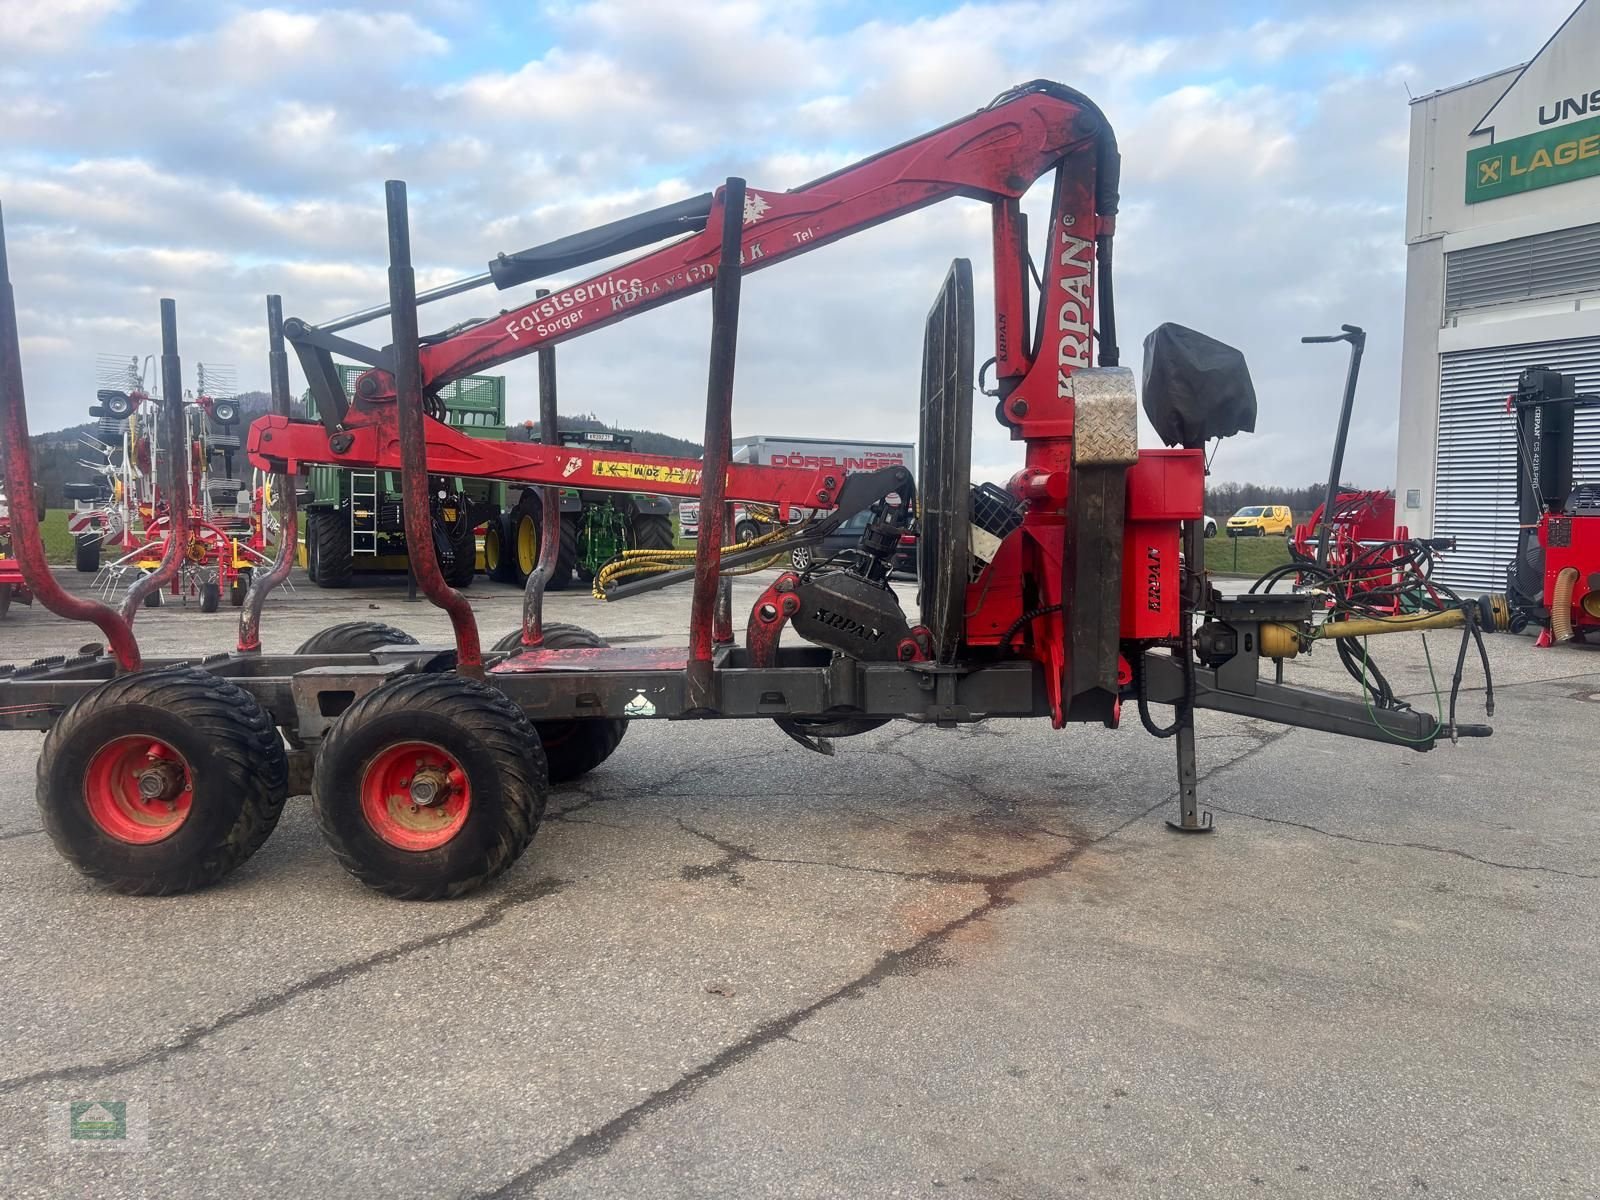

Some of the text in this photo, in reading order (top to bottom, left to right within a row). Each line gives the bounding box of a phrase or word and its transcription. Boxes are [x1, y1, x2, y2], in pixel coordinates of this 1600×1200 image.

[505, 276, 643, 341] Forstservice
[537, 309, 584, 337] Sorger
[998, 312, 1008, 362] KRPAN
[1147, 546, 1161, 613] KRPAN
[812, 607, 885, 643] KRPAN
